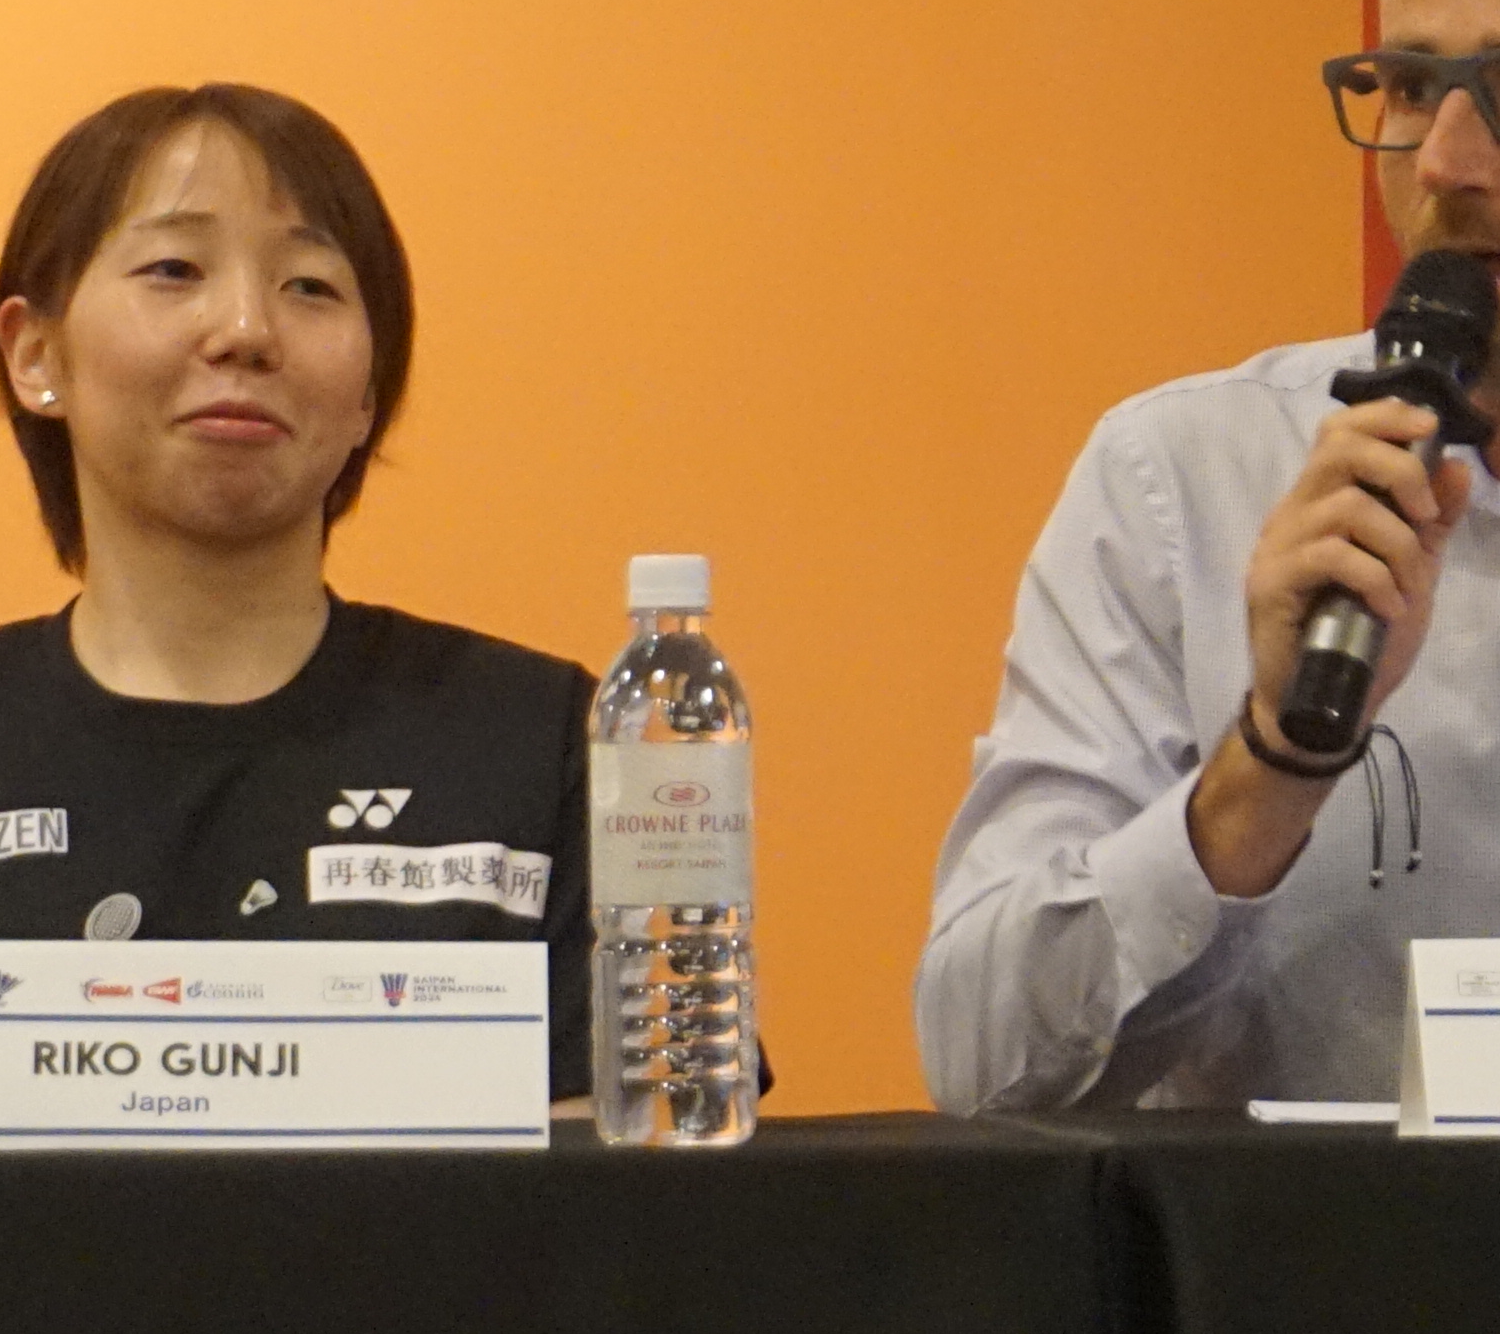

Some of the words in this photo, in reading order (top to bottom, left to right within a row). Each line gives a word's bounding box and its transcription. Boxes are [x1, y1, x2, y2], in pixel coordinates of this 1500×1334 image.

[32, 1040, 142, 1077] RIKO
[160, 1041, 301, 1079] GUNJI
[121, 1090, 211, 1117] Japan
